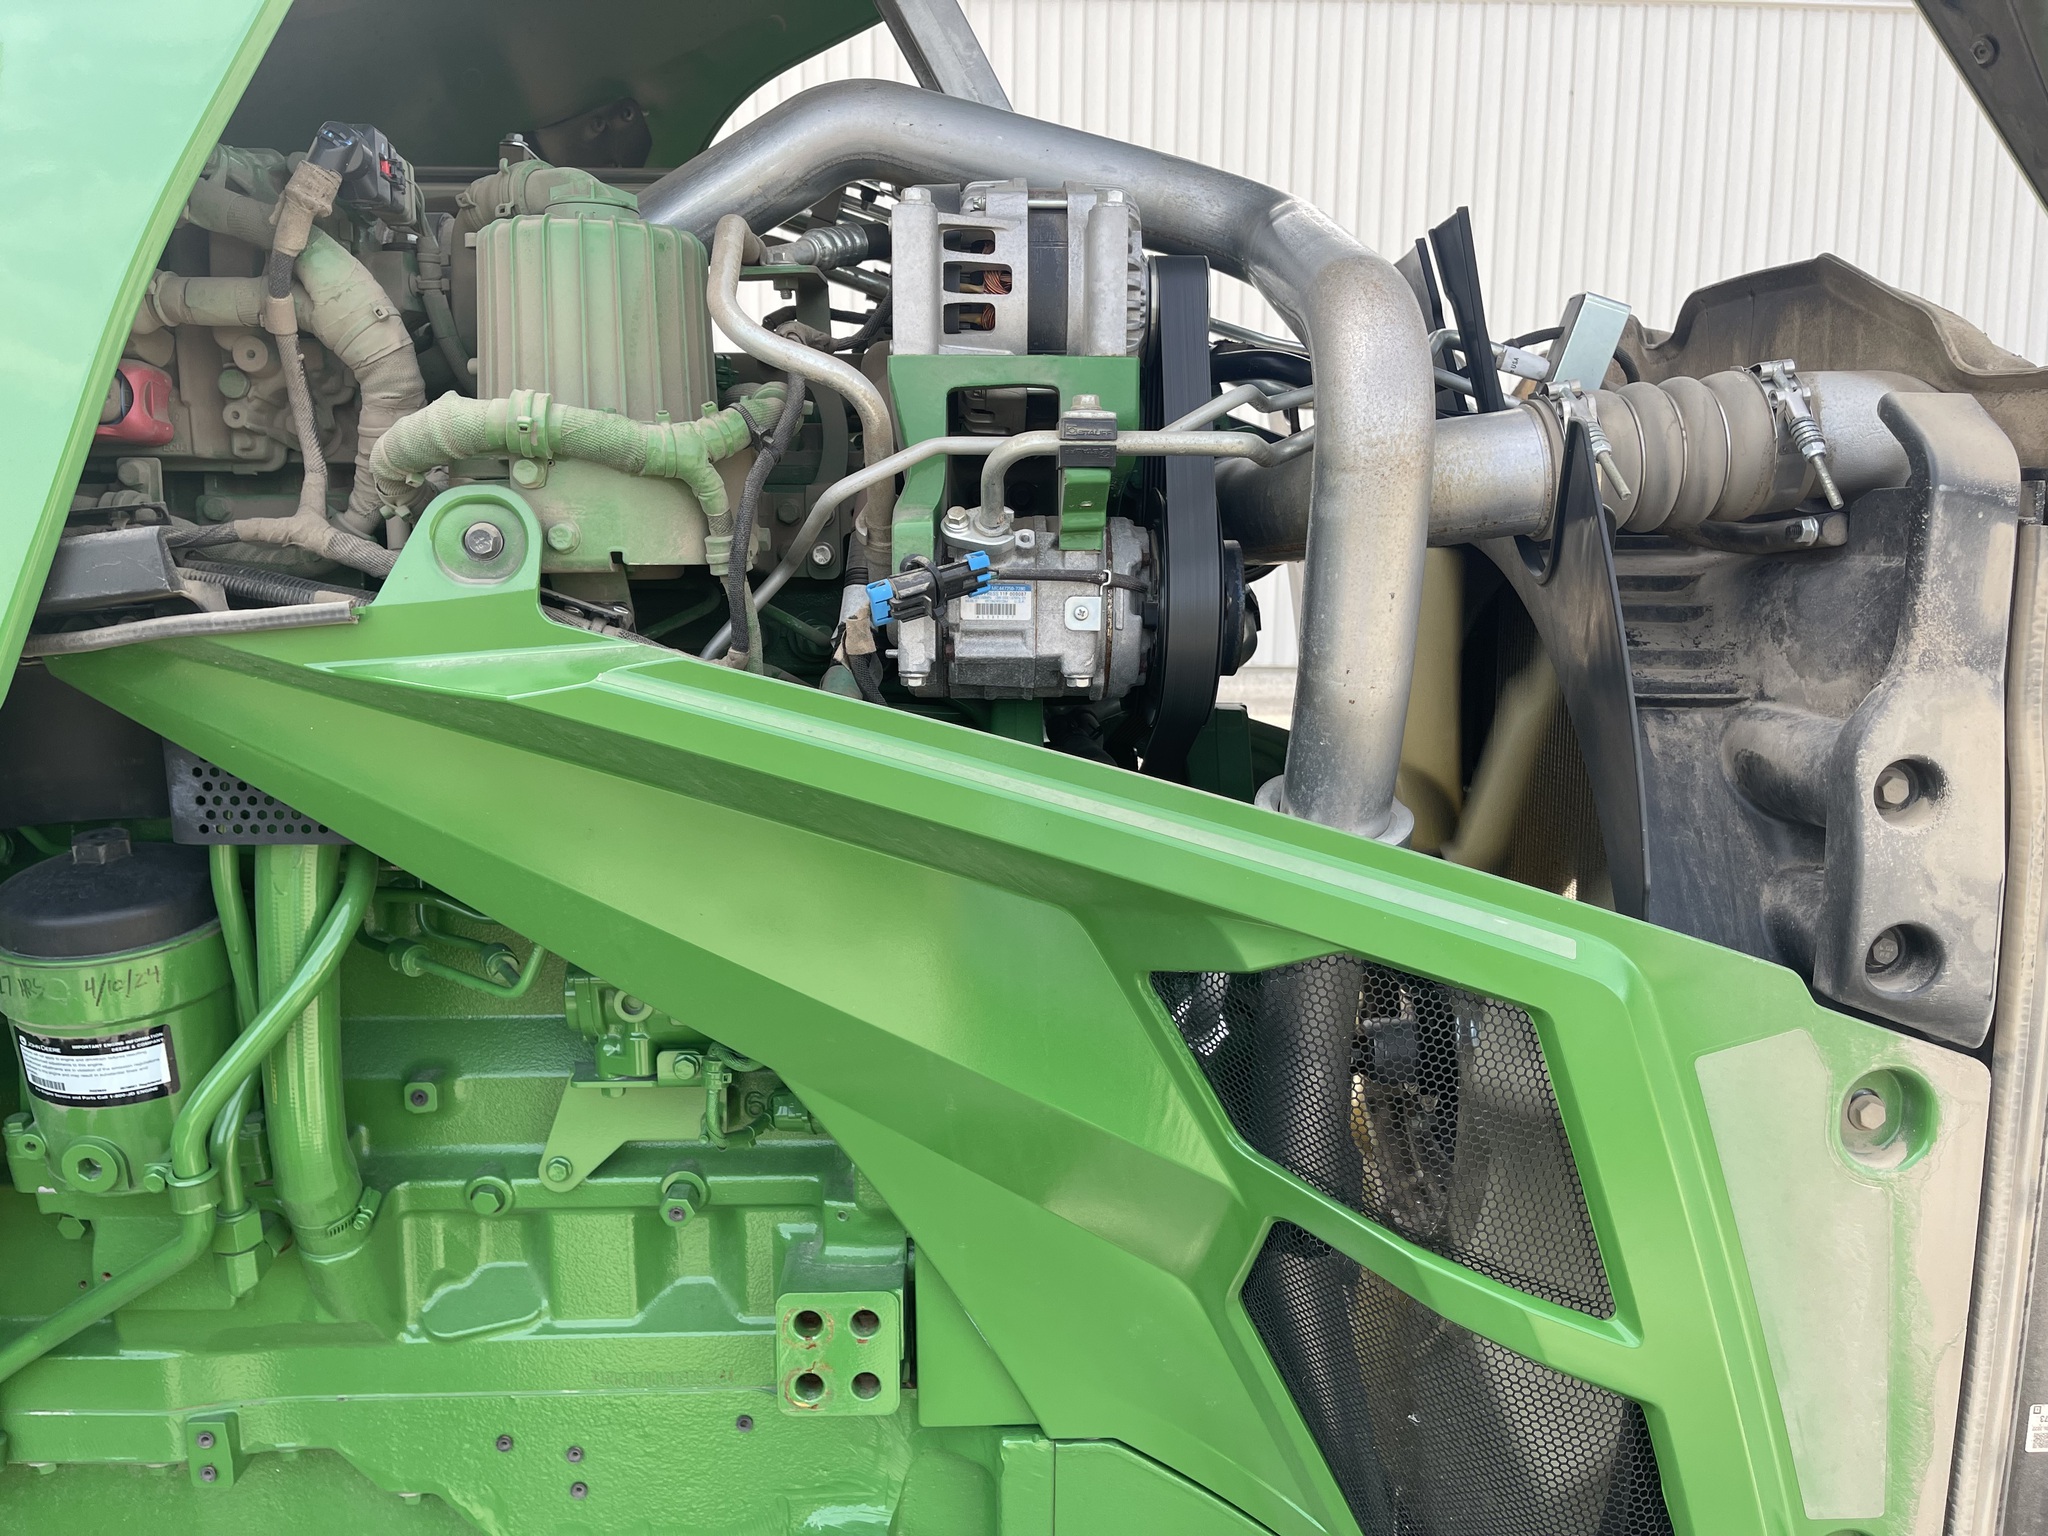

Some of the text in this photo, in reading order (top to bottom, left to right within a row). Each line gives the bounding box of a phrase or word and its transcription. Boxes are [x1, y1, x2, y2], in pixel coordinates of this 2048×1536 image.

[1511, 357, 1519, 369] USA
[84, 965, 160, 1007] 4/10/24
[111, 1045, 131, 1053] DEERE
[136, 1037, 163, 1048] COMPANY
[125, 1032, 163, 1045] INFORMATION
[28, 1041, 41, 1050] JOHN
[40, 1045, 62, 1054] DEERE
[136, 1086, 159, 1096] ENGINE
[744, 1091, 766, 1118] 6
